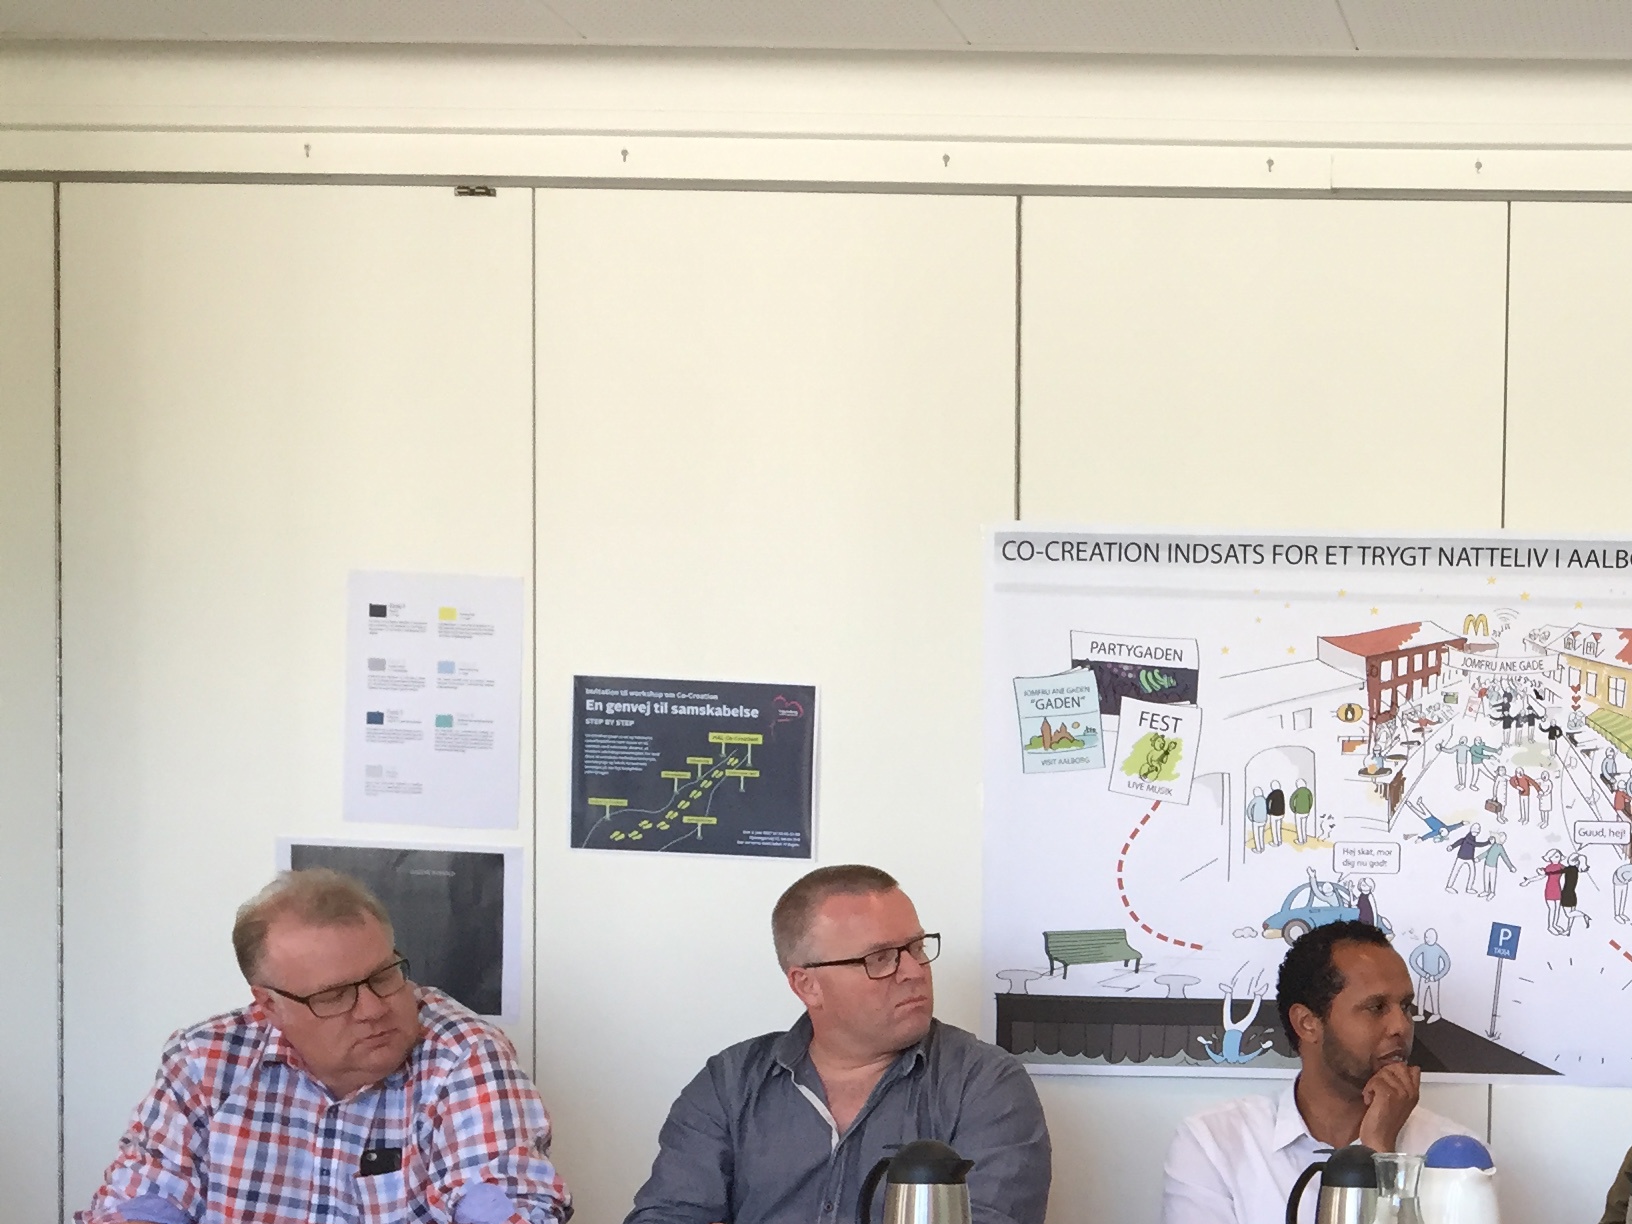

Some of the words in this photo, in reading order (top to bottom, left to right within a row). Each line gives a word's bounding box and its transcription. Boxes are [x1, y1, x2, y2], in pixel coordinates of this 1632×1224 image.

[1002, 540, 1160, 564] CO-CREATION
[1168, 542, 1264, 566] INDSATS
[1272, 544, 1318, 566] FOR
[1325, 546, 1352, 566] ET
[1358, 546, 1432, 568] TRYGT
[1438, 546, 1550, 568] NATTELIV
[1555, 548, 1560, 568] I
[1090, 640, 1184, 662] PARTYGADEN
[1460, 656, 1498, 672] JOMFRU
[1500, 660, 1516, 672] ANE
[1520, 660, 1544, 670] GADE
[585, 698, 603, 712] En
[606, 700, 651, 717] genvej
[654, 700, 668, 715] til
[670, 702, 760, 718] samskabelse
[584, 718, 604, 726] STEP
[604, 718, 615, 726] BY
[616, 719, 635, 727] STEP
[1138, 710, 1183, 734] FEST
[1040, 758, 1057, 766] VISIT
[1058, 756, 1091, 766] AALBORG
[1127, 780, 1144, 792] LIVE
[1146, 784, 1174, 796] MUSIK
[1578, 828, 1606, 838] Guud,
[1608, 828, 1626, 840] hej!
[1498, 928, 1512, 946] P
